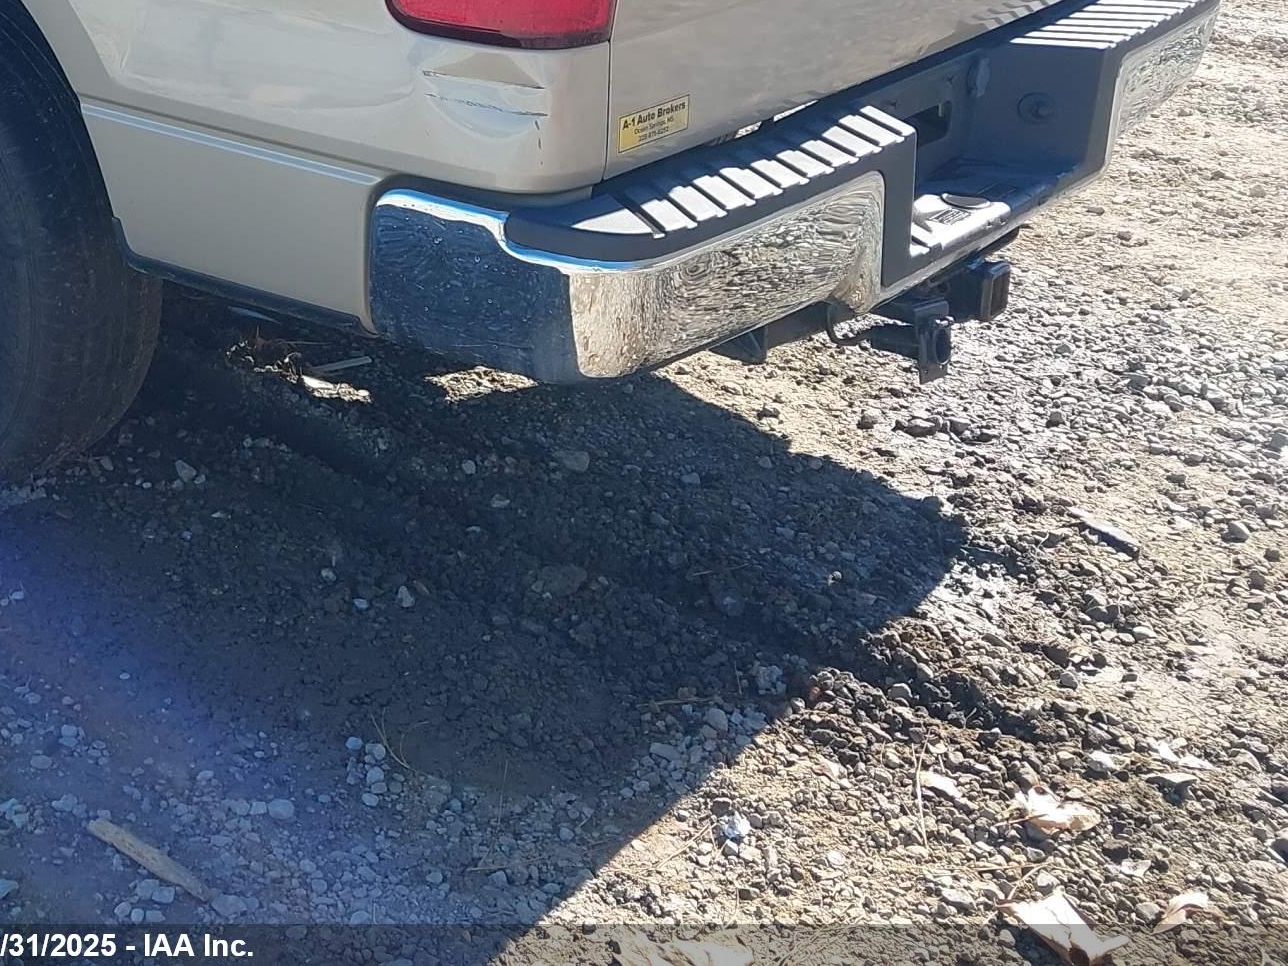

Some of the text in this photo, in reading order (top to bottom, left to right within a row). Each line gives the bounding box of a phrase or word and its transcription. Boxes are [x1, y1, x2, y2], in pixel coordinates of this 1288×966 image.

[623, 102, 686, 130] A-1 Auto Brokers
